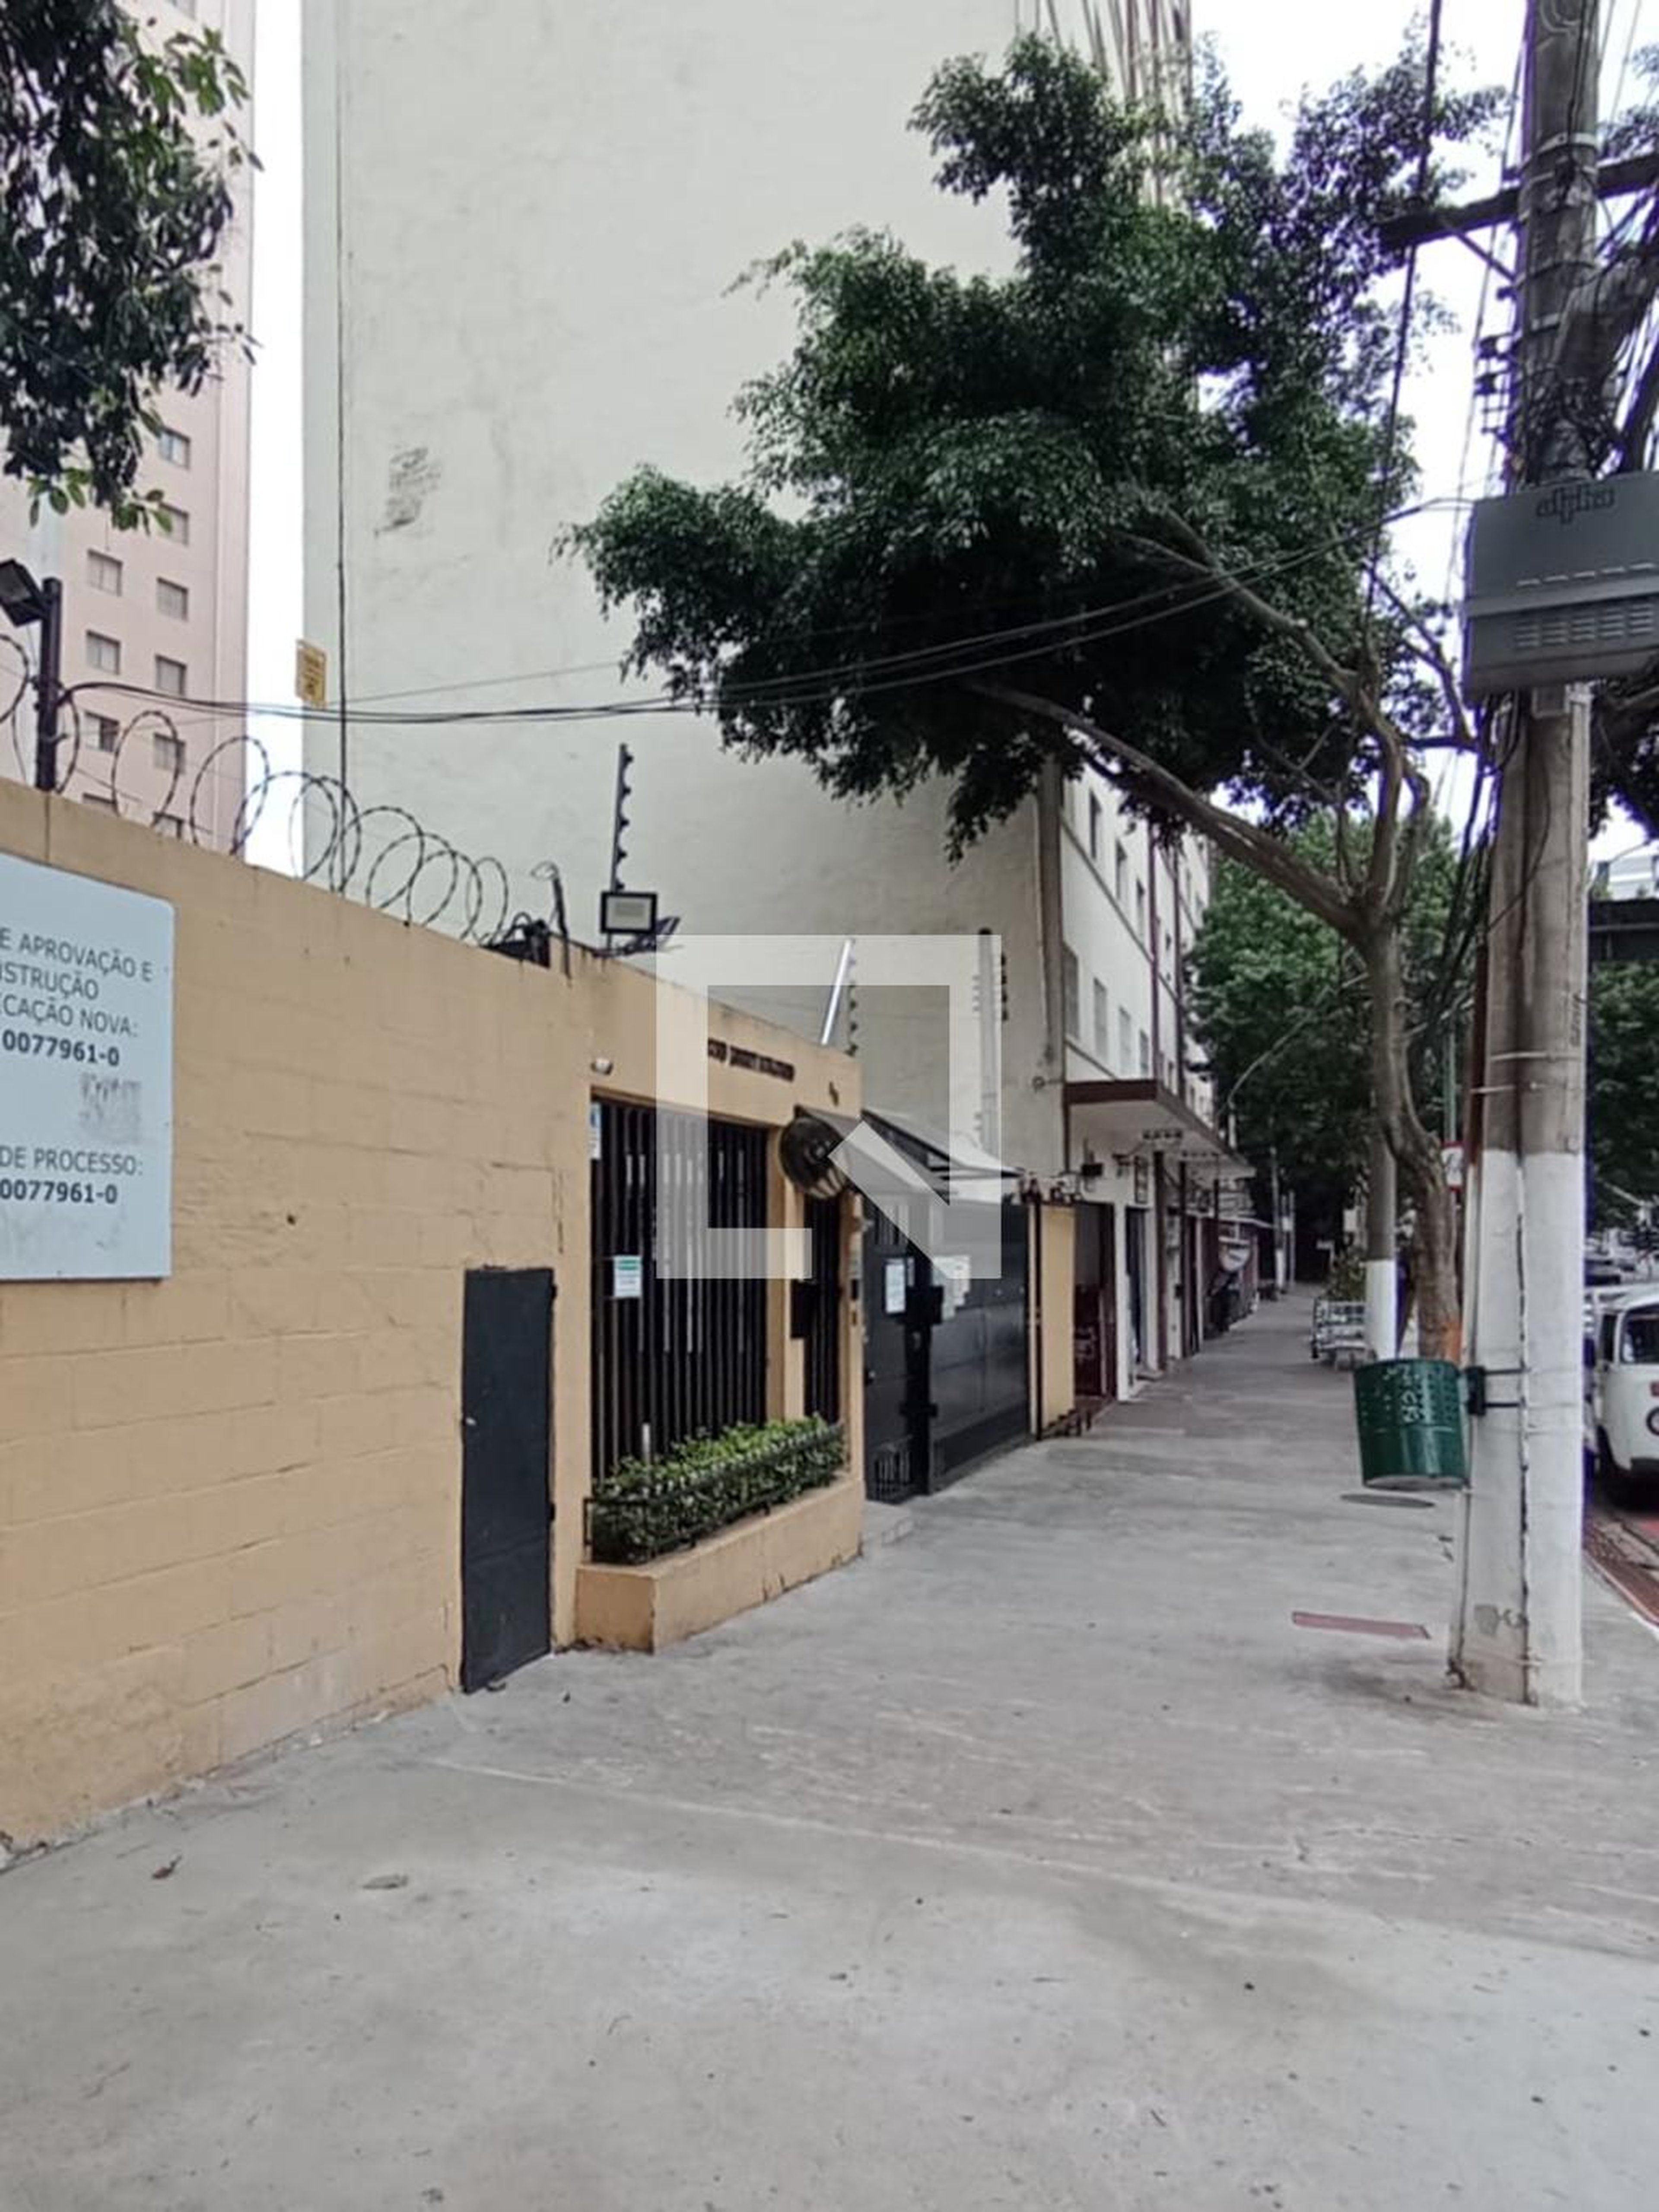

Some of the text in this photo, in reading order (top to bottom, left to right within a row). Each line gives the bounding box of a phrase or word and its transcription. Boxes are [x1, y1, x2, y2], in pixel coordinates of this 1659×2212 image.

[19, 933, 136, 978] APROVAÇÃO
[141, 961, 153, 982] E
[0, 961, 99, 1000] STRUÇÃO
[80, 1008, 140, 1038] NOVA:
[2, 1029, 120, 1067] 0077961-0
[0, 1146, 143, 1176] DE PROCESSO:
[0, 1178, 118, 1204] 0077961-0
